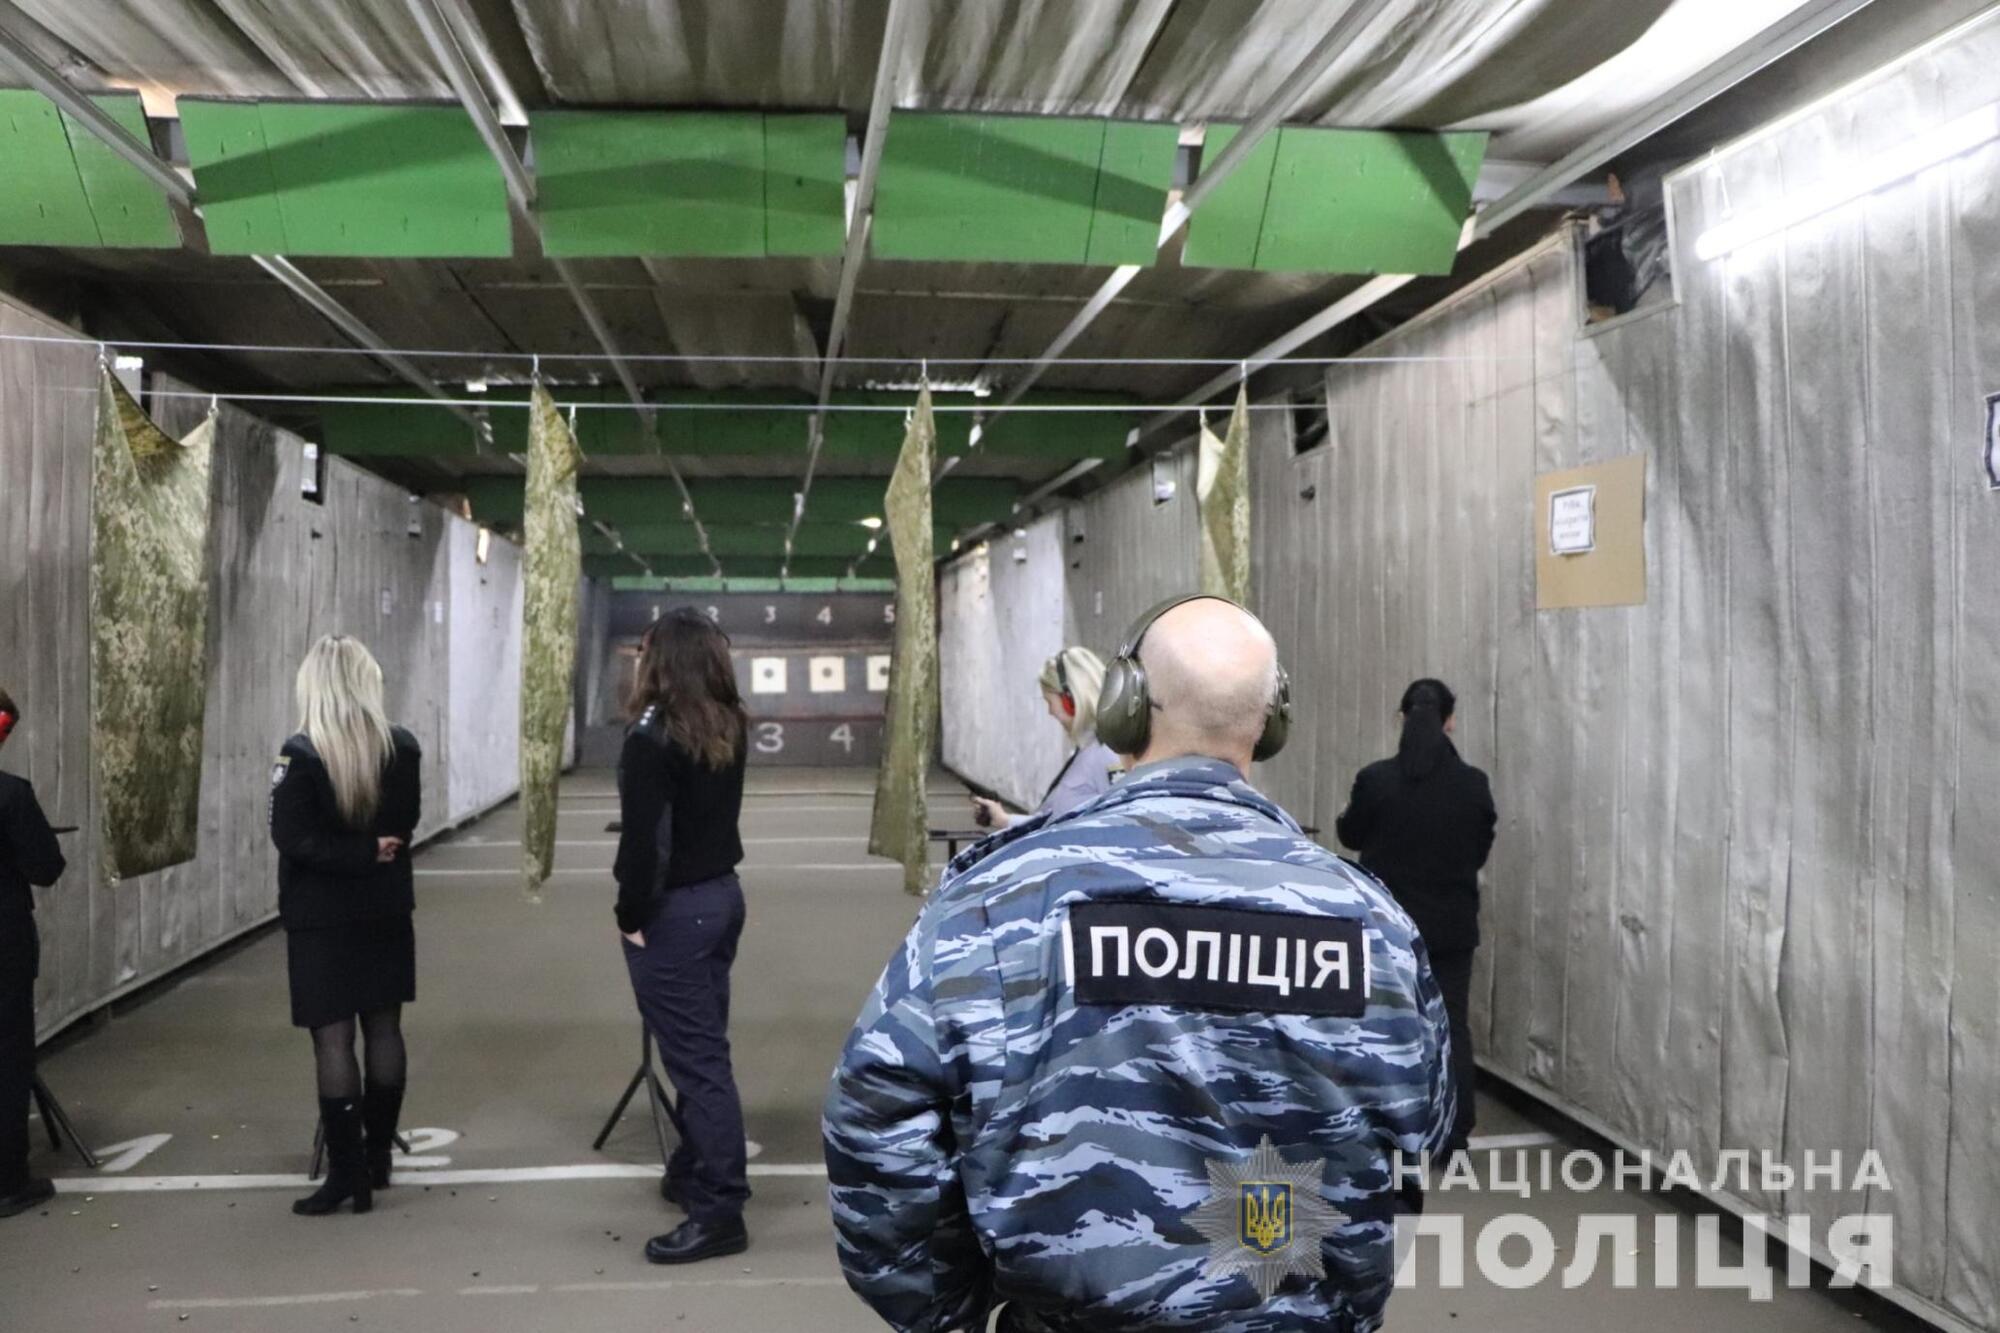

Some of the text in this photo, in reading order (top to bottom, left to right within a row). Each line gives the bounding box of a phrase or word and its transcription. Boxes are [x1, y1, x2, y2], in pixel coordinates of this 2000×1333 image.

[652, 605, 660, 621] 1
[765, 605, 776, 623] 3
[816, 605, 832, 625] 4
[884, 604, 895, 623] 5
[756, 721, 855, 753] 3 4
[1089, 925, 1350, 996] ПОЛІЦІЯ
